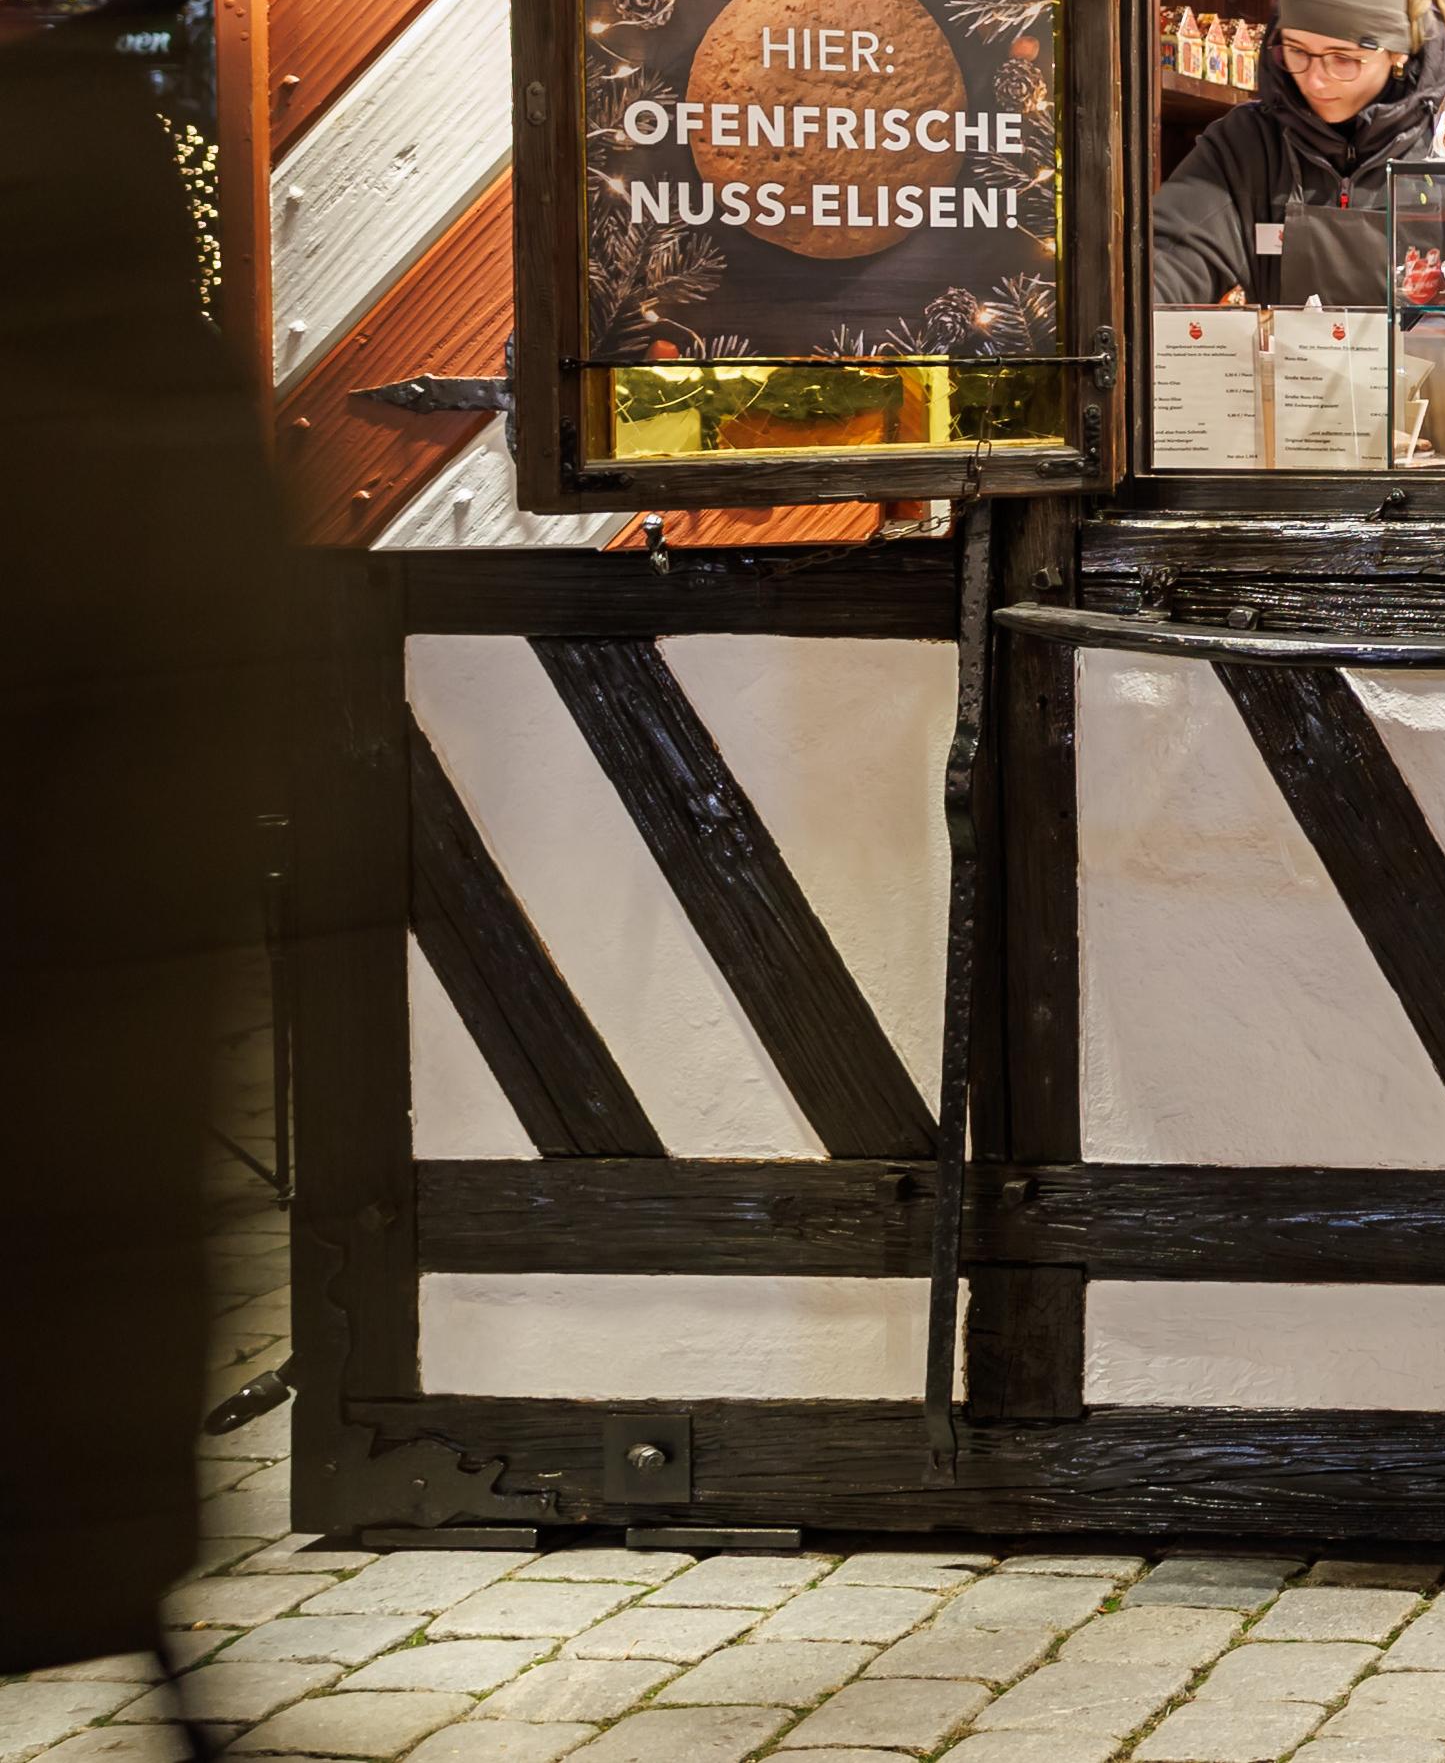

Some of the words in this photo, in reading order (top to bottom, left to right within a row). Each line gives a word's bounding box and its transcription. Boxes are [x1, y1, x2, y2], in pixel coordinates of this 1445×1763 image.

[762, 26, 895, 74] HIER:
[623, 100, 1024, 154] OFENFRISCHE
[630, 181, 1018, 229] NUSS-ELISEN!
